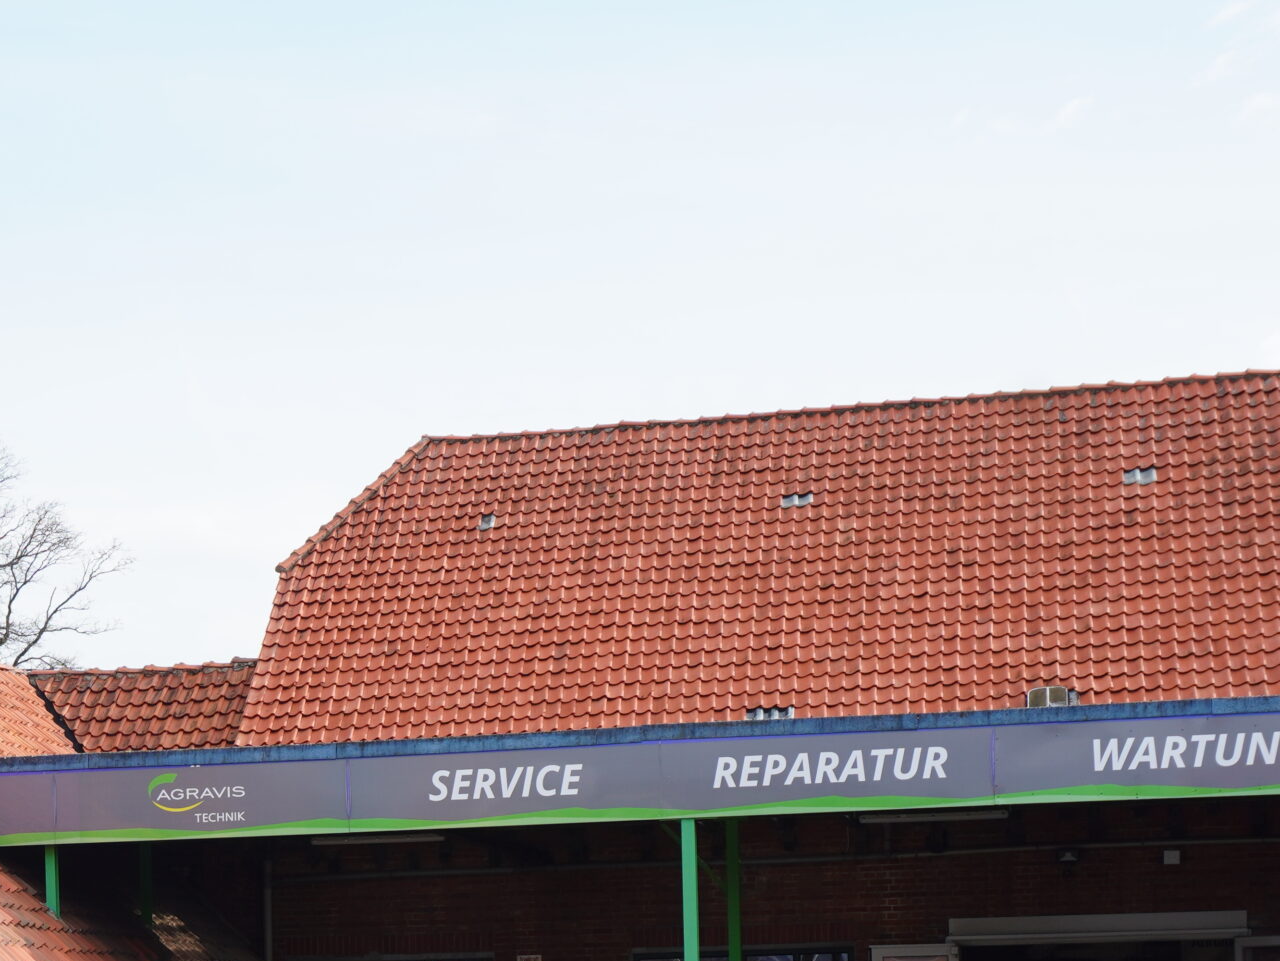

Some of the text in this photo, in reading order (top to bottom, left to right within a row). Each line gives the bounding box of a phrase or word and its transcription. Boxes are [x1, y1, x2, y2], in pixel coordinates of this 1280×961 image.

[712, 745, 949, 789] REPARATUR
[155, 785, 246, 801] AGRAVIS
[428, 763, 584, 802] SERVICE
[194, 810, 246, 824] TECHNIK
